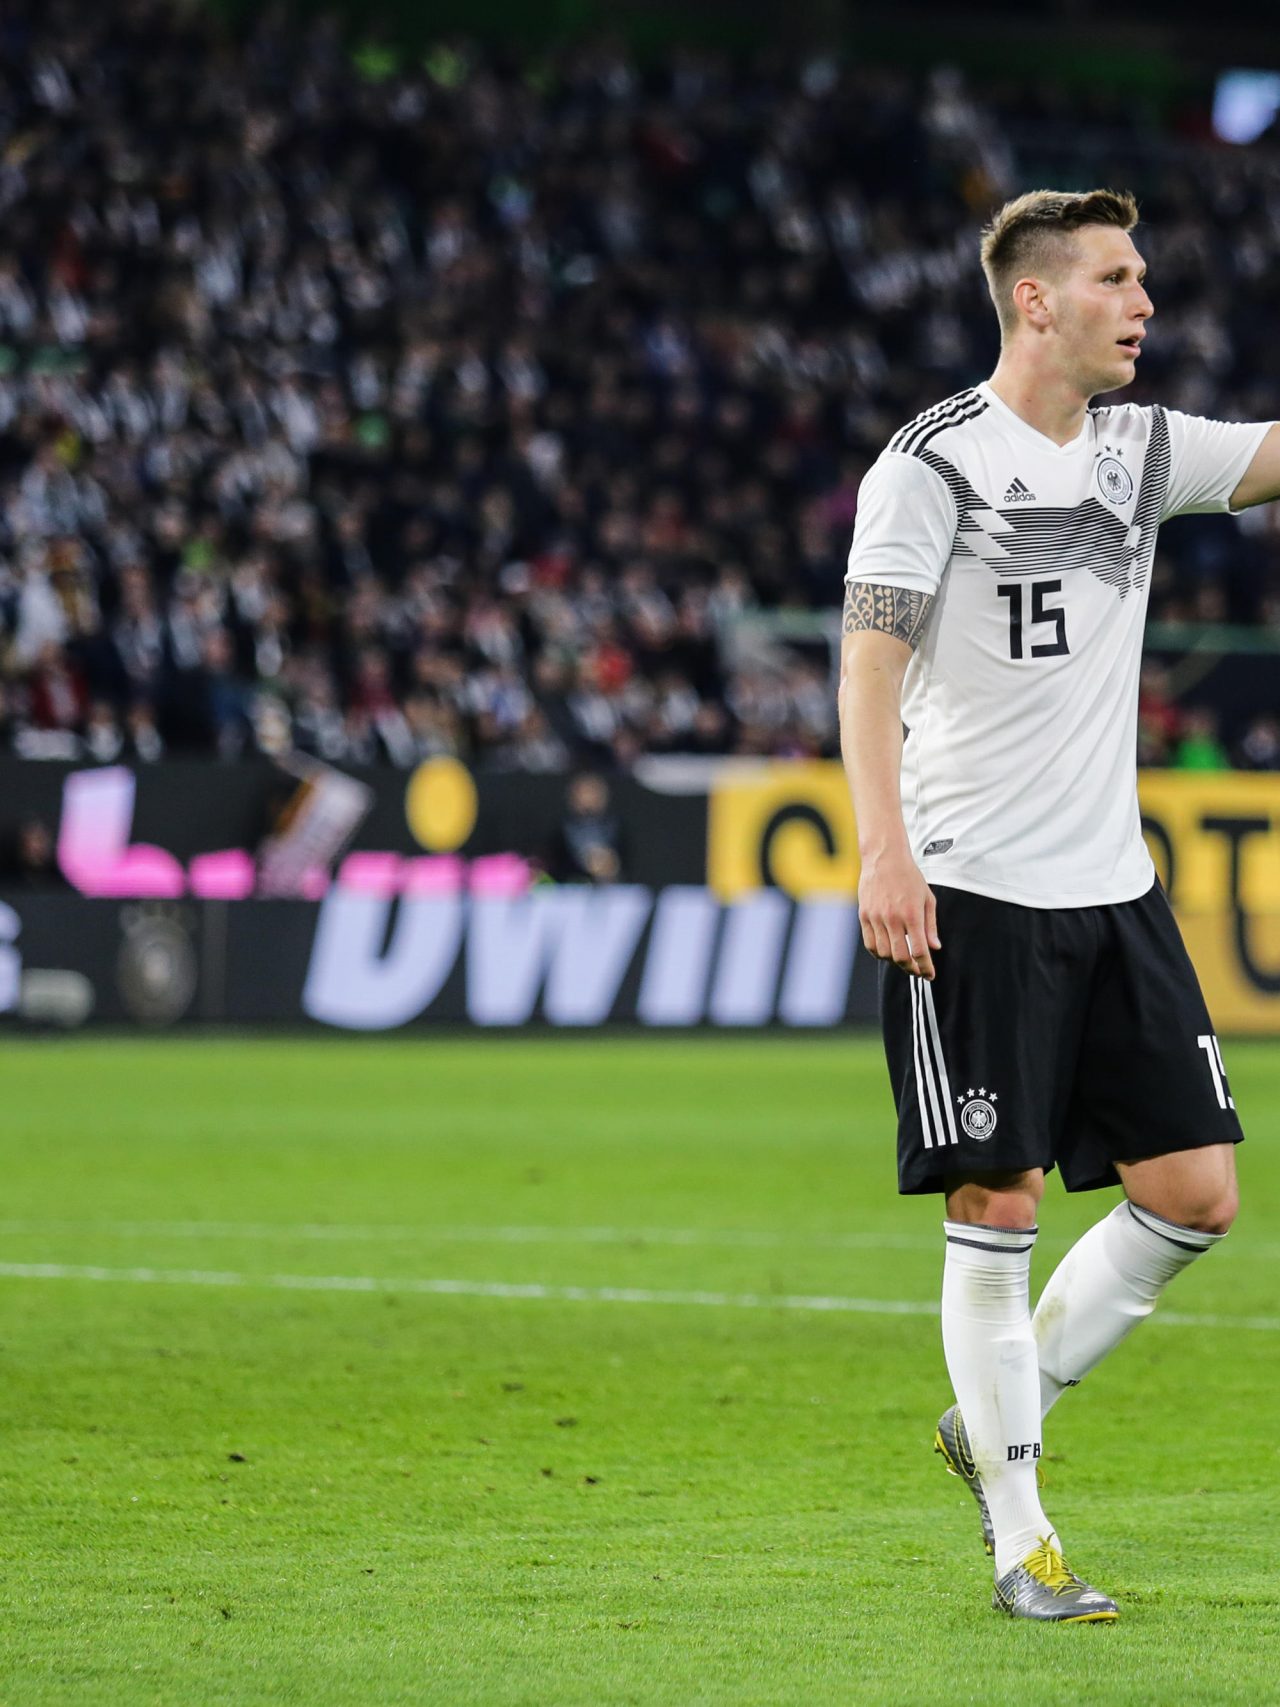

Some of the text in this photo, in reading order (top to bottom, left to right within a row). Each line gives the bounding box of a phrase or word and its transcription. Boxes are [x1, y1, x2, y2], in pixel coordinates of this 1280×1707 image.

[1003, 493, 1036, 503] adidas
[997, 579, 1071, 660] 15
[1197, 1034, 1236, 1110] 1
[1006, 1442, 1041, 1462] DFB
